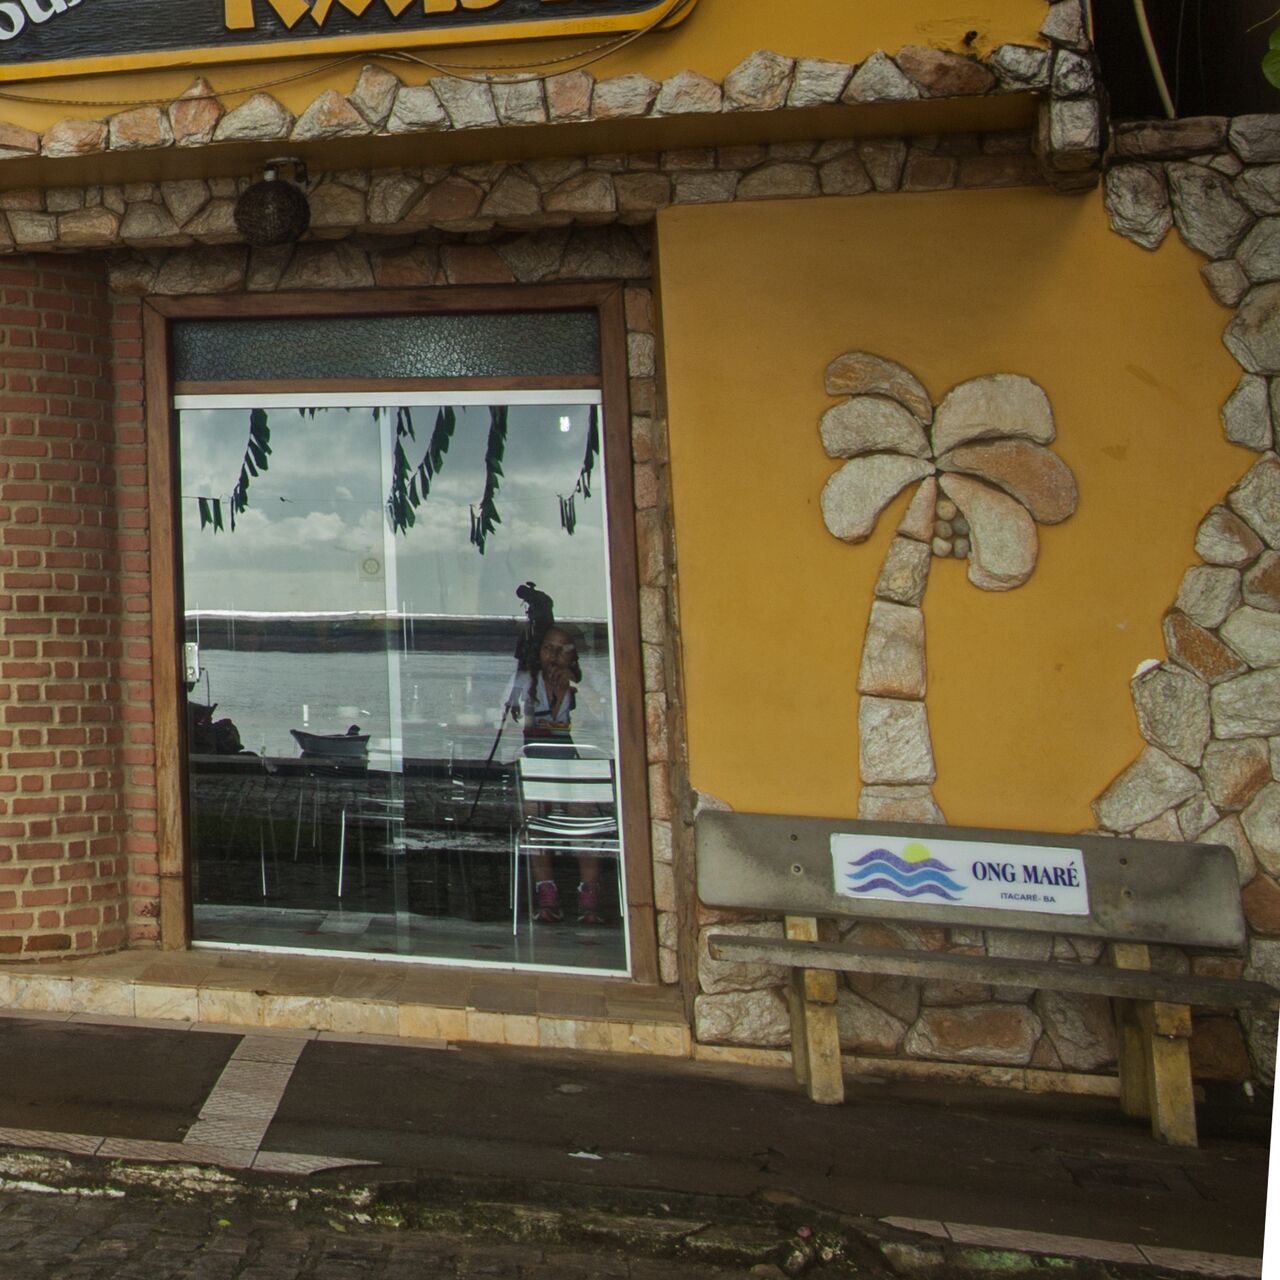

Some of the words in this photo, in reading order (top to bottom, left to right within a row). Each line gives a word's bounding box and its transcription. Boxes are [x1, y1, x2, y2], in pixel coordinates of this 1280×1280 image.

[972, 861, 1016, 883] ONG
[1022, 861, 1080, 888] MARÉ
[1043, 895, 1057, 904] BA
